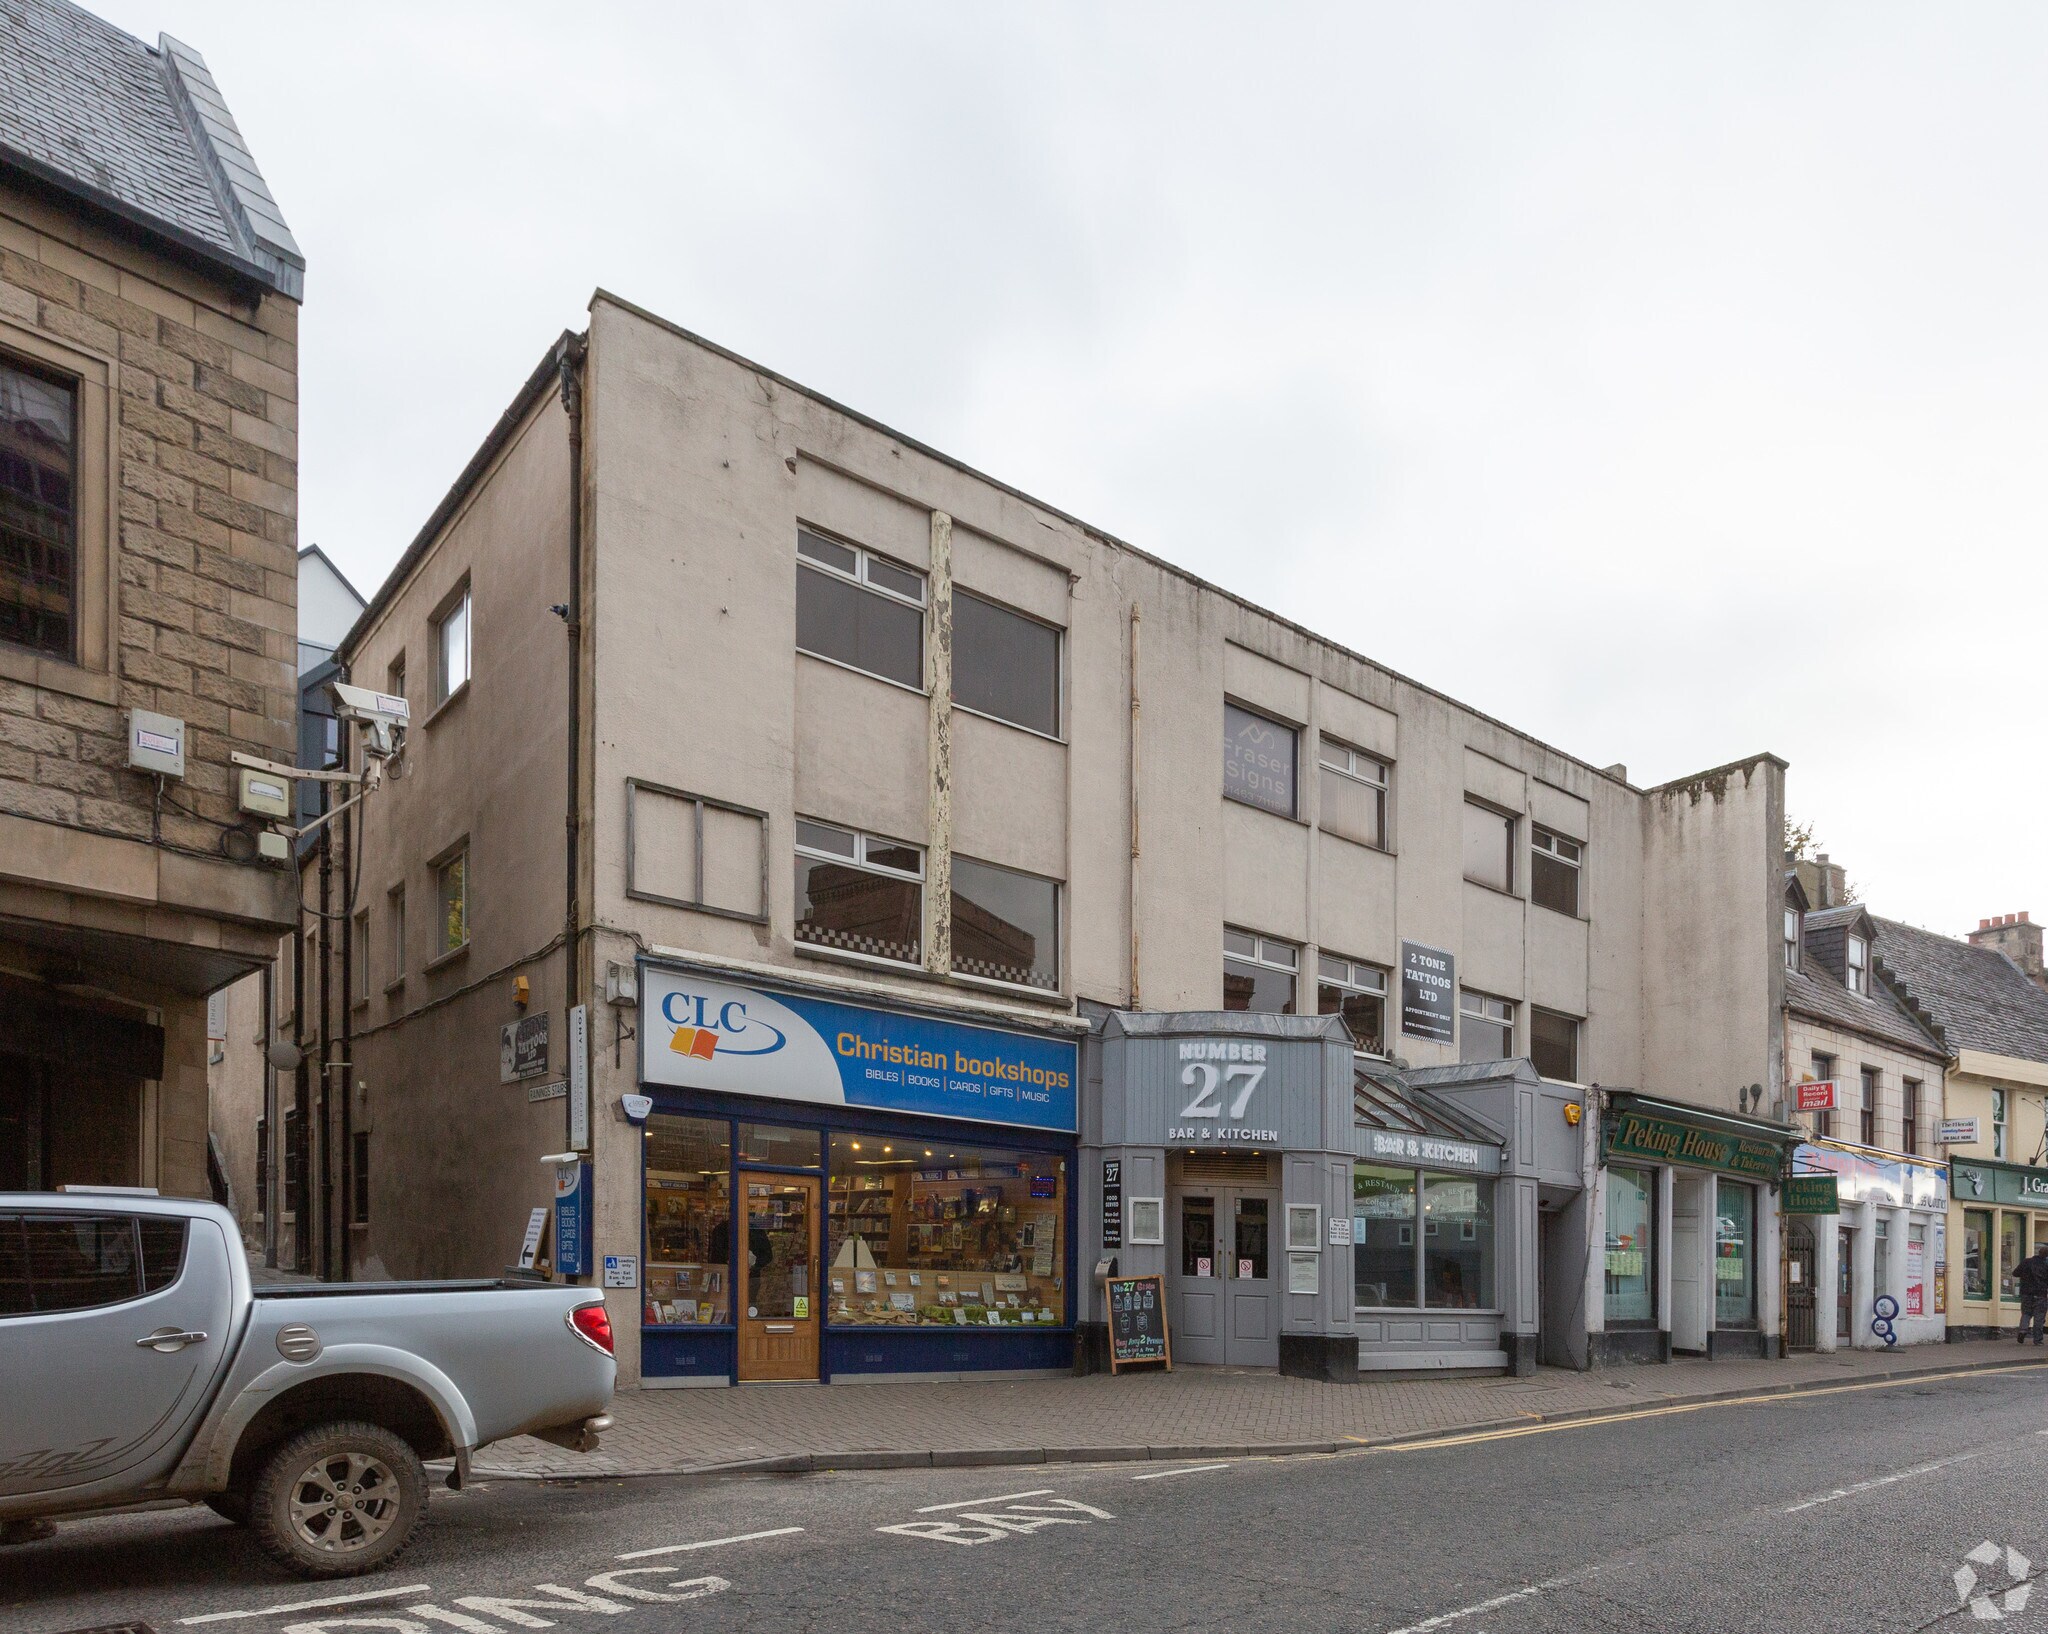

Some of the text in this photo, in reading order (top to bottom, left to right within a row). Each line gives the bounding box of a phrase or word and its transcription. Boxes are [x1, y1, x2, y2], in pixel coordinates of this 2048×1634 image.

[1226, 760, 1285, 795] Signs
[1411, 953, 1446, 972] 2 TONE
[1405, 968, 1451, 989] TATTOOS
[1419, 989, 1438, 1002] LTD
[662, 991, 747, 1033] CLC
[1405, 1006, 1451, 1021] APPOINTMENT ONLY
[518, 1032, 548, 1055] TATTOOS
[1180, 1043, 1266, 1061] NUMBER
[837, 1032, 1069, 1090] Christian bookshops
[865, 1068, 1050, 1102] BIBLES BOOKS CARDS GIFTS MUSIC
[1180, 1063, 1266, 1119] 27
[1803, 1096, 1828, 1107] mail
[1169, 1127, 1278, 1141] BAR & KITCHEN
[1623, 1119, 1729, 1162] Peking House
[1374, 1135, 1478, 1164] BAR & KITCHEN
[1738, 1140, 1777, 1157] Restaurant
[1731, 1156, 1737, 1166] &
[1106, 1168, 1118, 1181] 27
[1788, 1180, 1831, 1196] Peking
[2024, 1176, 2031, 1195] J.
[1790, 1194, 1831, 1206] House
[561, 1206, 575, 1216] BIBLES
[561, 1218, 575, 1227] BOOKS
[561, 1229, 576, 1239] CARDS
[561, 1241, 574, 1250] GIFTS
[561, 1253, 576, 1262] MUSIC
[1140, 1335, 1146, 1344] 2
[875, 1498, 1117, 1545] BAY
